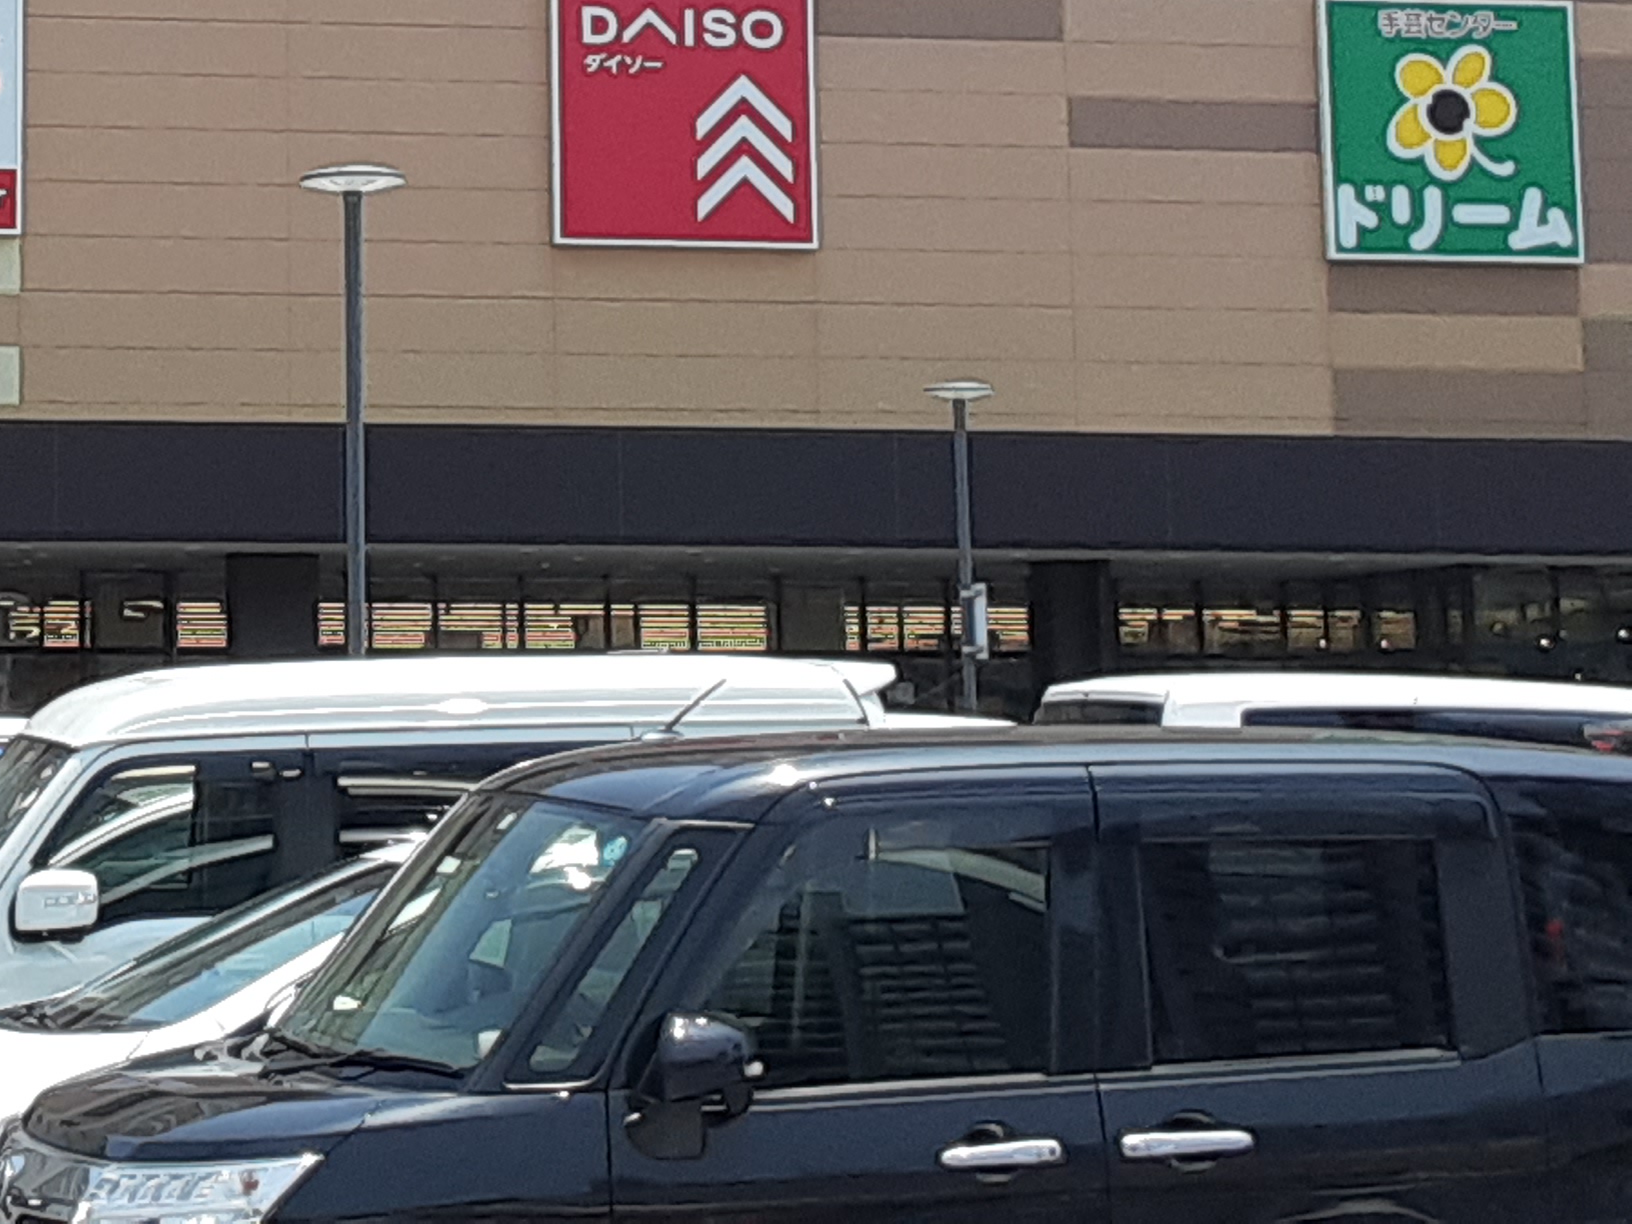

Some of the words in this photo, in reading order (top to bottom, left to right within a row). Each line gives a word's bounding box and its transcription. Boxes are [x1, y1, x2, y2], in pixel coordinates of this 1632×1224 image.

[580, 5, 784, 49] DAISO
[583, 53, 663, 74] ダイソー
[1337, 183, 1573, 251] ドリーム
